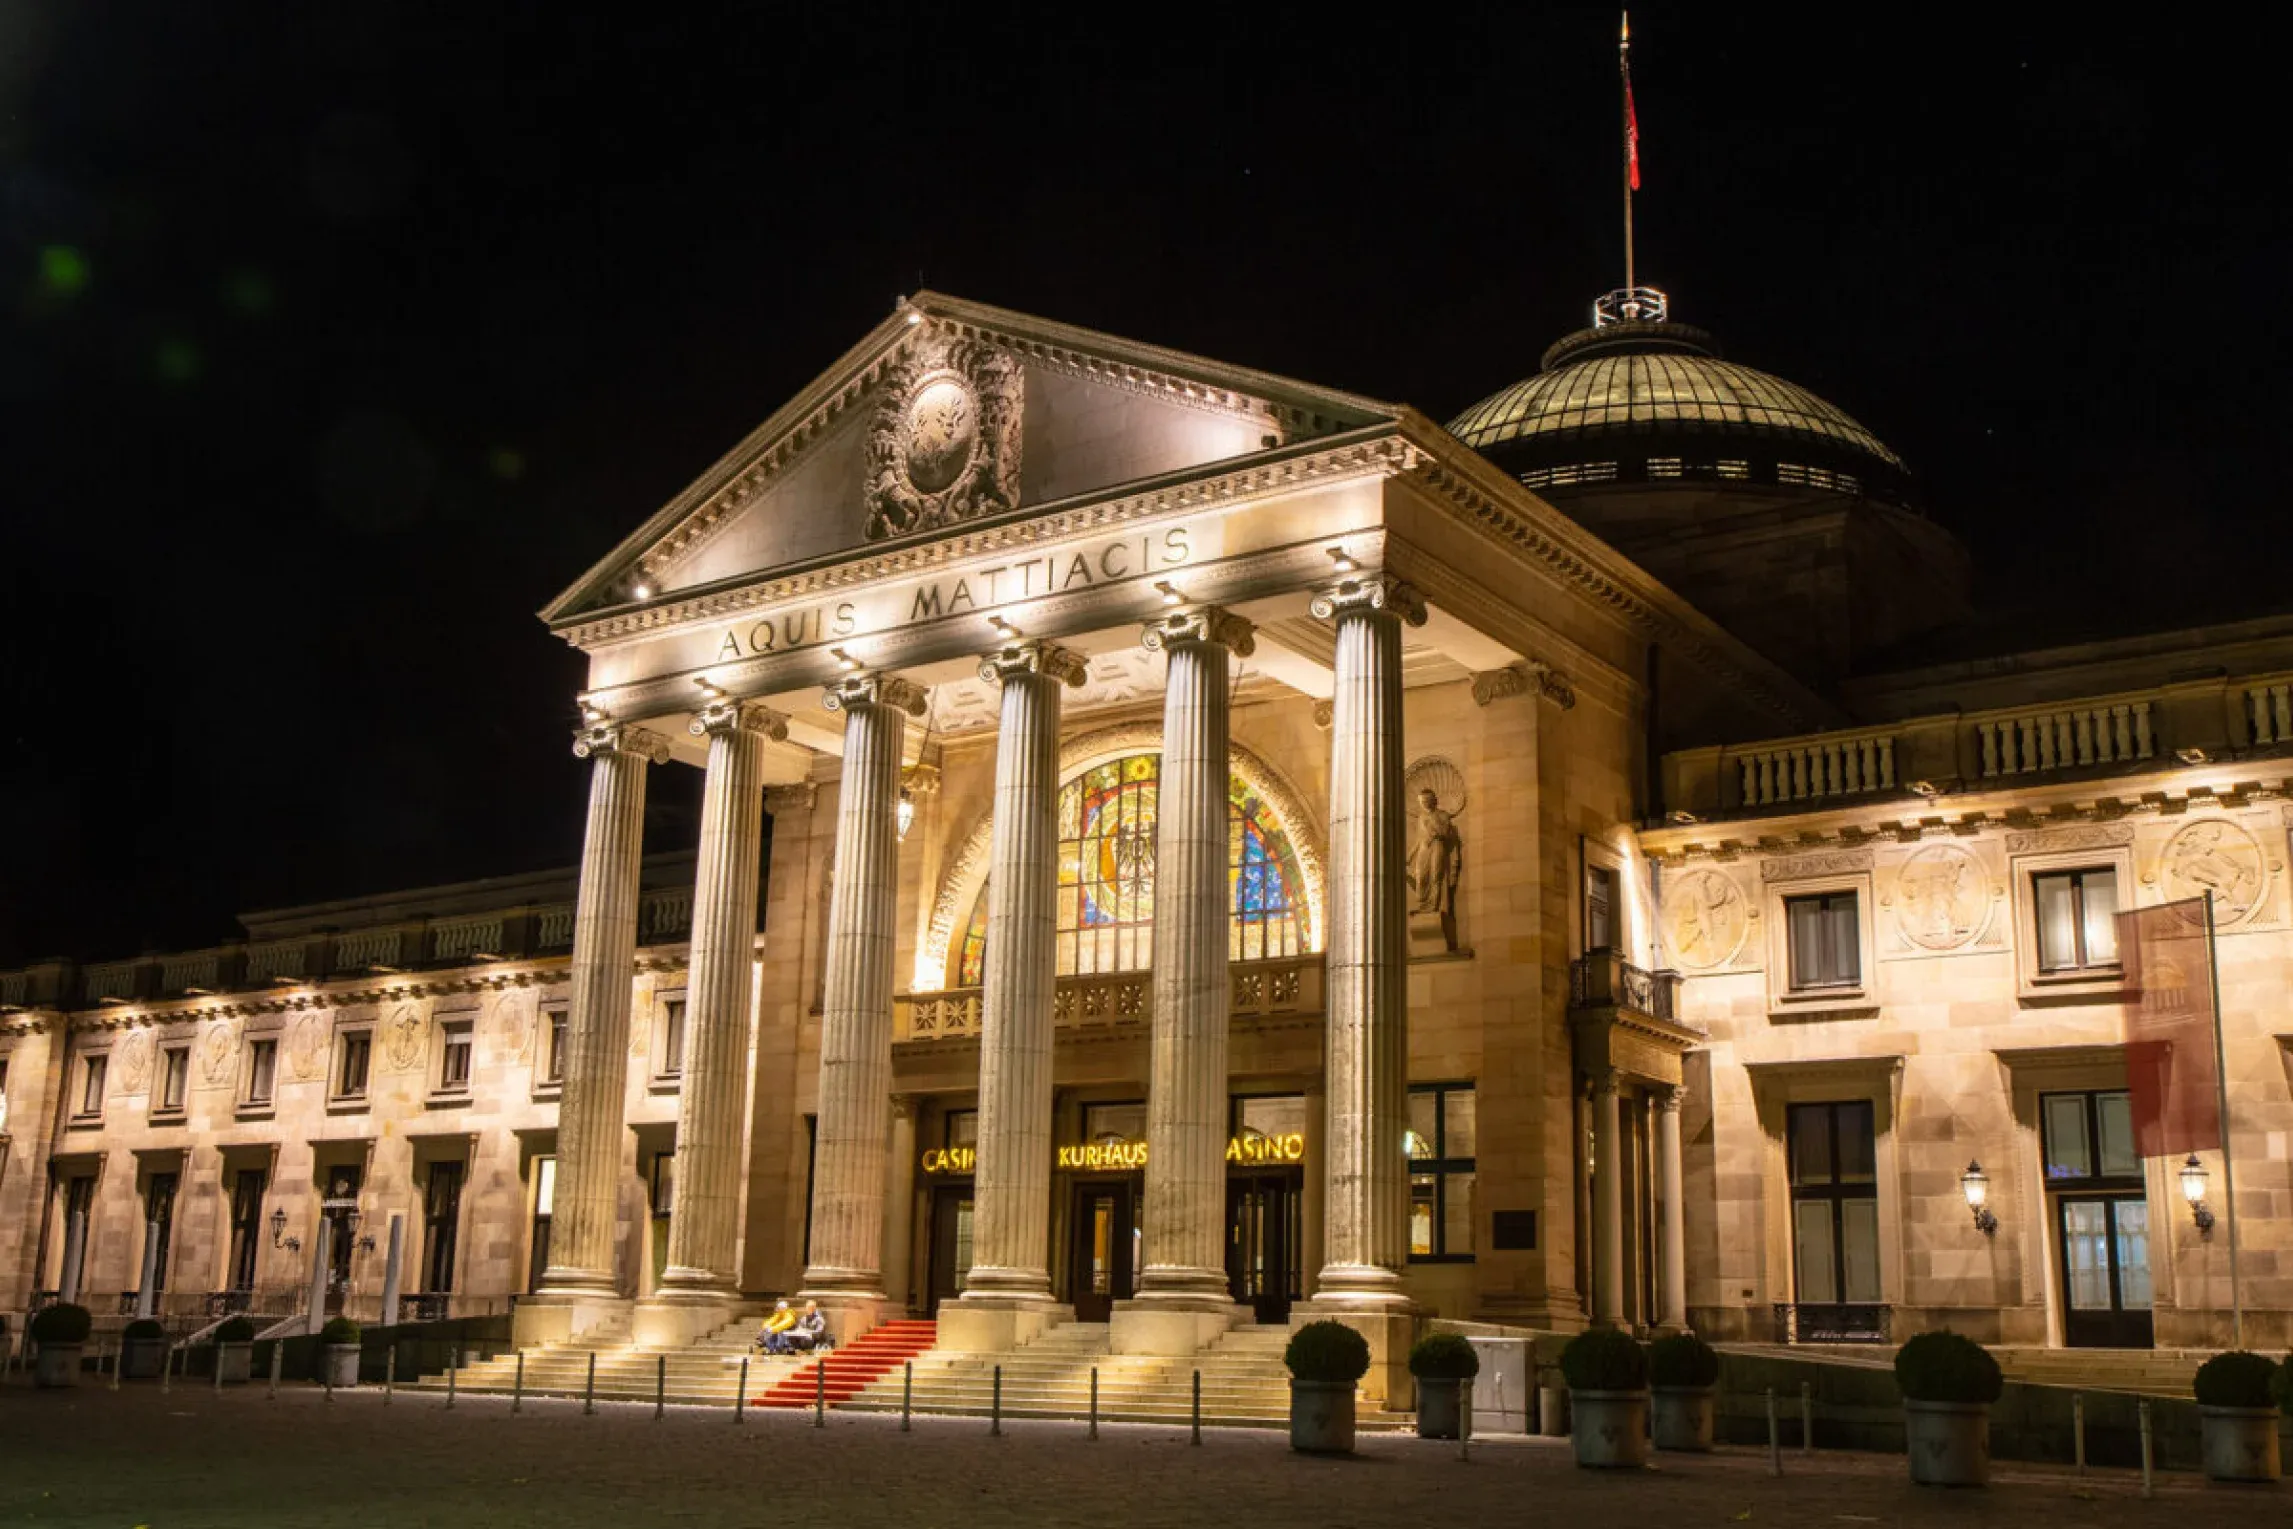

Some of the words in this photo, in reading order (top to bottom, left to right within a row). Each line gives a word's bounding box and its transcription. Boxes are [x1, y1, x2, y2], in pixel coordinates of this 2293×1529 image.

[718, 603, 855, 661] AQUIS
[911, 528, 1189, 620] MATTIACIS
[922, 1147, 977, 1172] CASI
[1058, 1142, 1148, 1168] KURHAUS
[1224, 1133, 1304, 1161] ASINO
